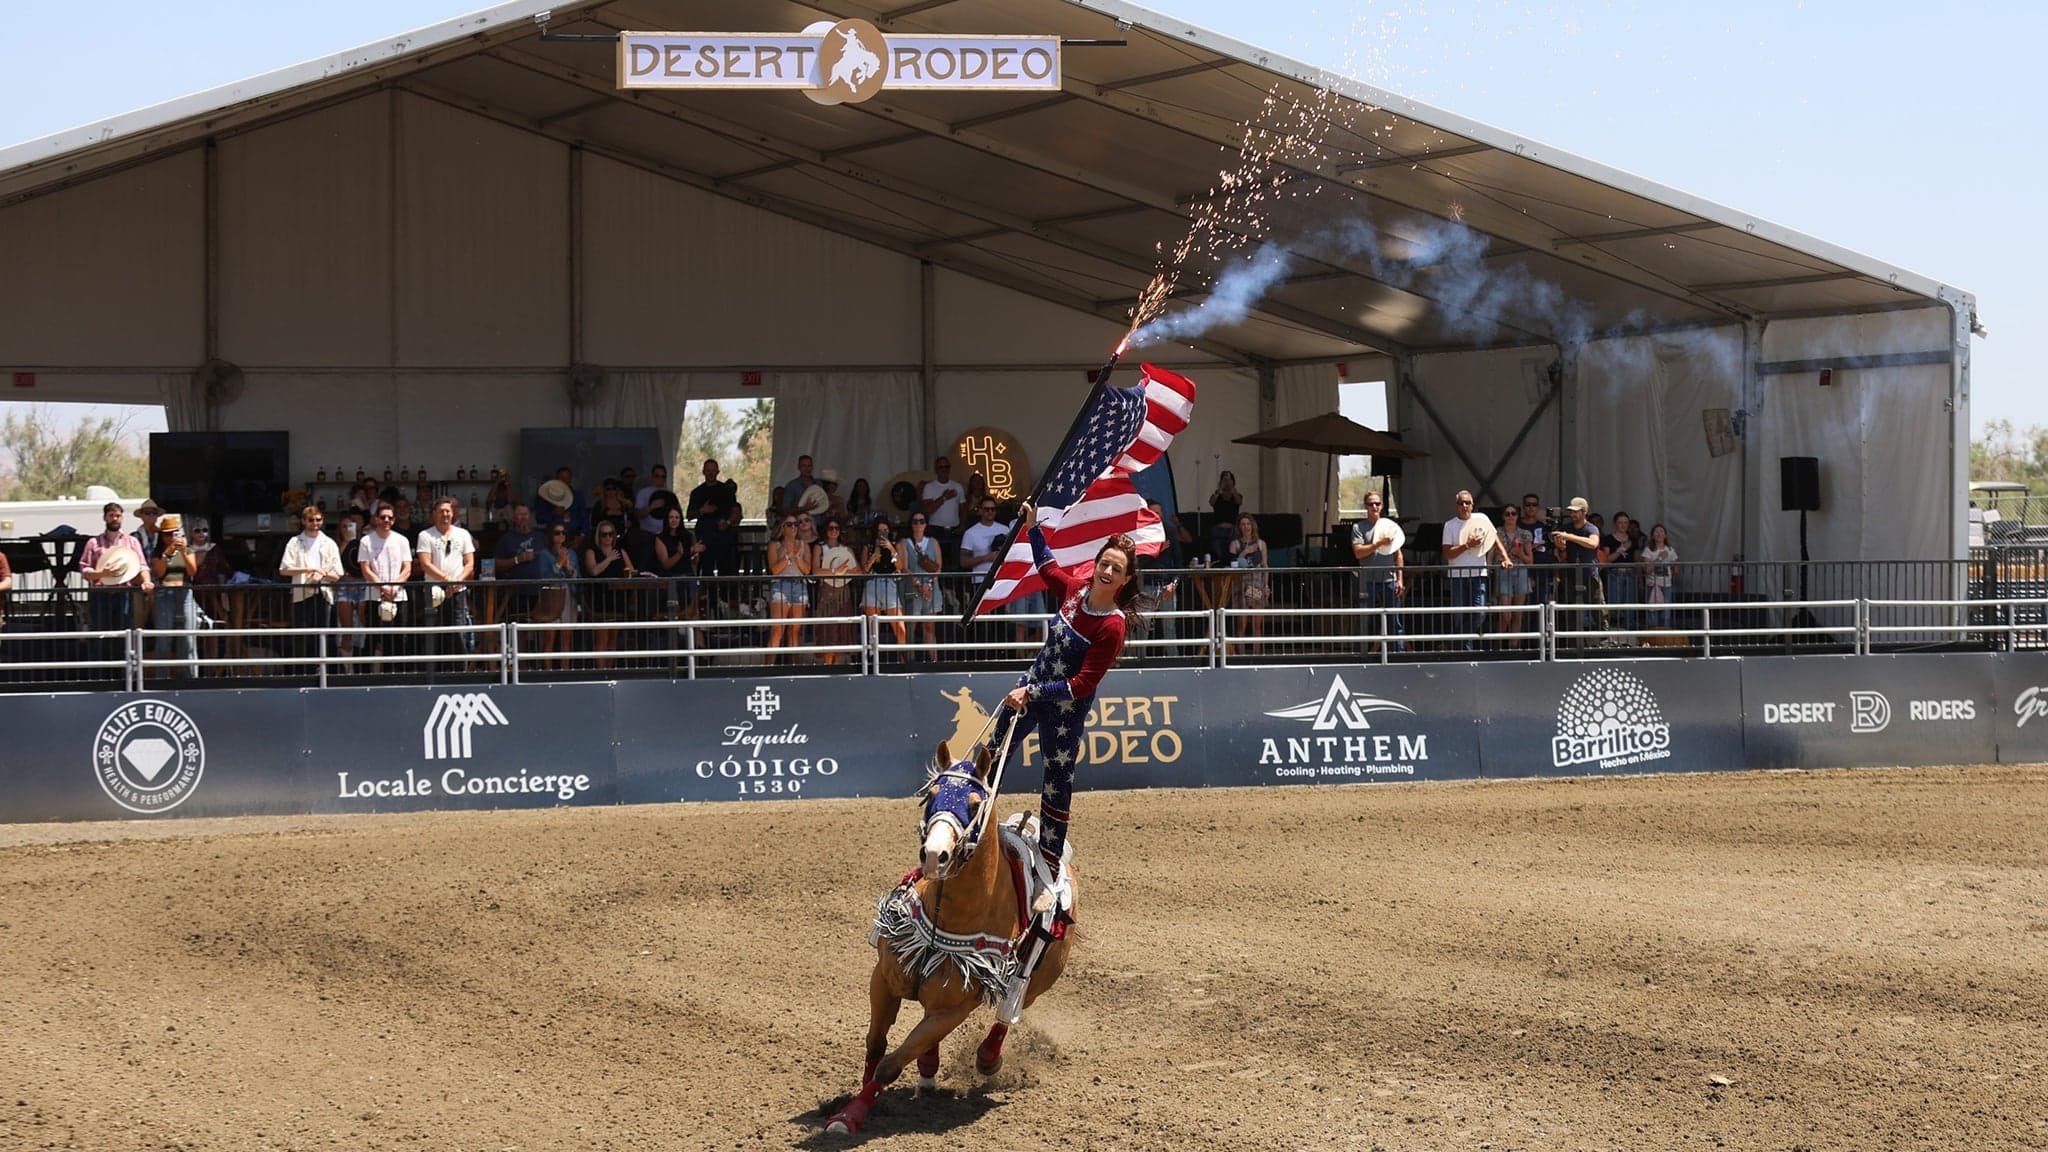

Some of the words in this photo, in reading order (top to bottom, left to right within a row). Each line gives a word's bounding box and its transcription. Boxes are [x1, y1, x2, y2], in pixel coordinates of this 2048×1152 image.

[630, 44, 815, 79] DESERT
[894, 47, 1053, 80] RODEO
[102, 706, 140, 744] ELITE
[145, 704, 195, 743] EQUINE
[1764, 702, 1836, 724] DESERT
[1909, 699, 1976, 721] RIDERS
[721, 720, 809, 758] Tequila
[1022, 729, 1182, 767] RDEO
[1259, 734, 1429, 764] ANTHEM
[1553, 725, 1669, 766] Barrilitos
[695, 754, 839, 779] CÓDIGO
[1275, 767, 1316, 778] Cooling
[1320, 765, 1361, 776] Heating
[1366, 763, 1415, 775] Plumbing
[1600, 757, 1628, 769] Hecho
[1628, 755, 1640, 765] en
[104, 766, 131, 799] HEALTH
[140, 764, 197, 806] PERFORMANCE
[338, 768, 432, 798] Locale
[441, 768, 590, 800] Concierge
